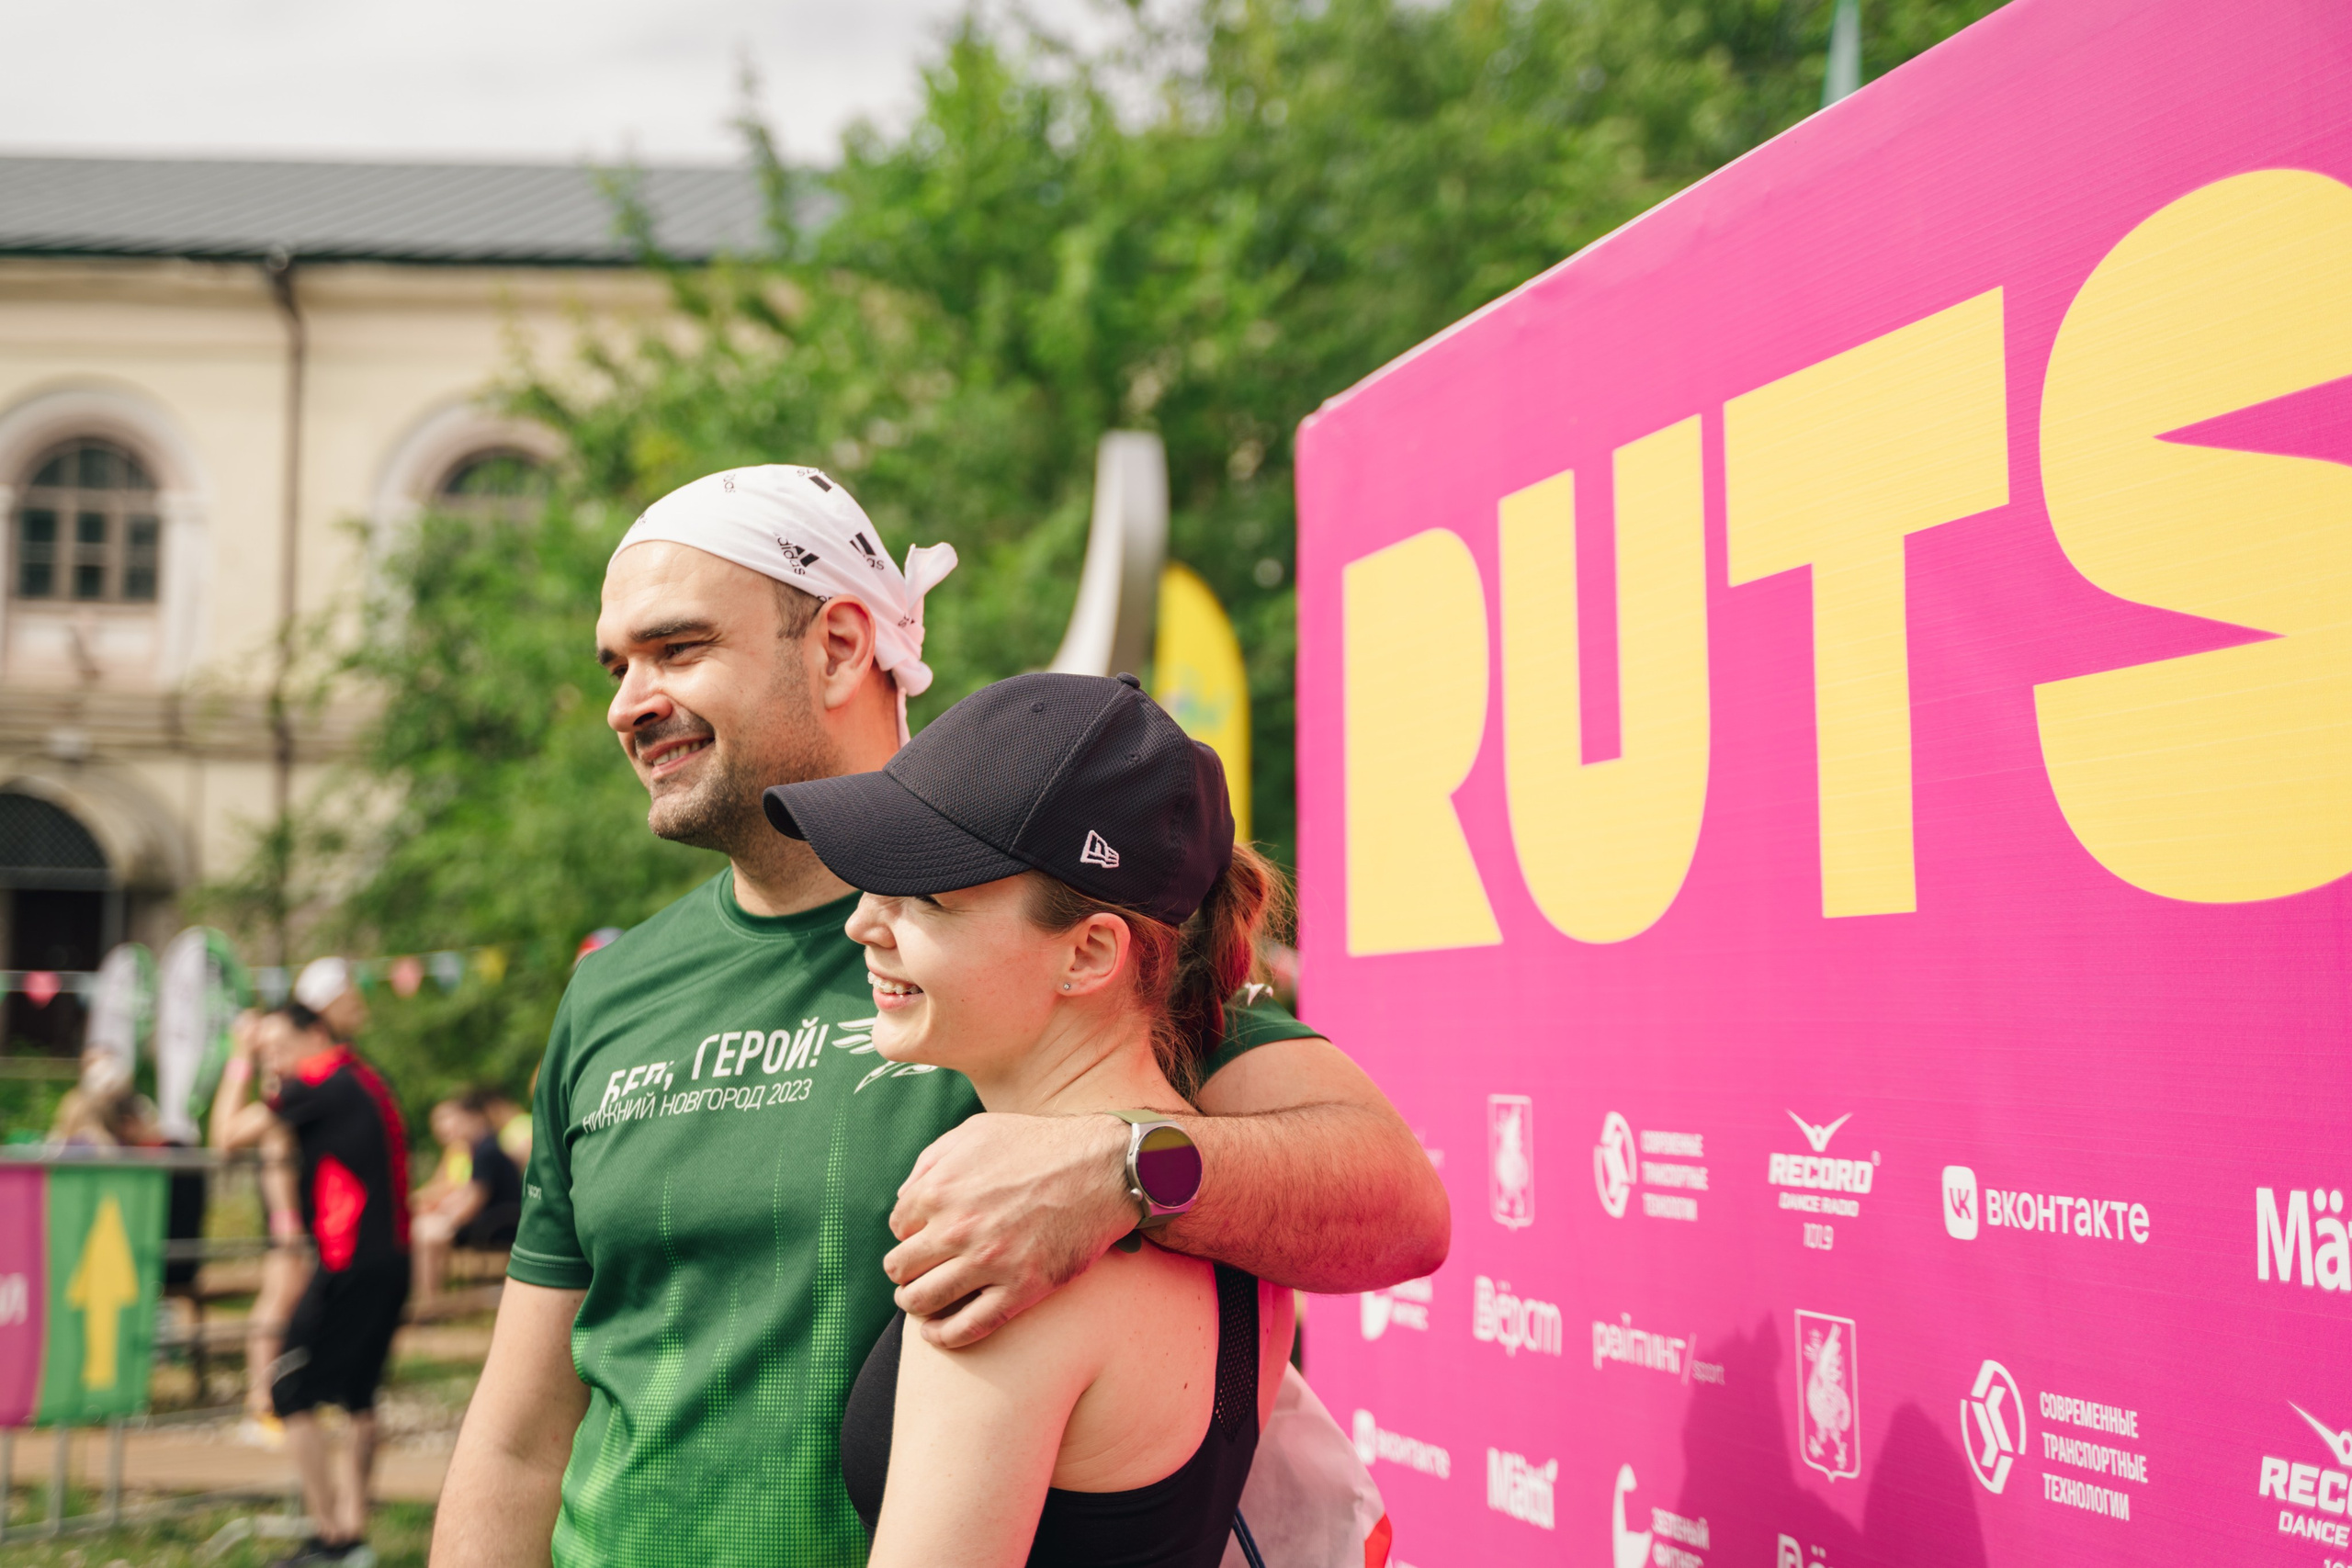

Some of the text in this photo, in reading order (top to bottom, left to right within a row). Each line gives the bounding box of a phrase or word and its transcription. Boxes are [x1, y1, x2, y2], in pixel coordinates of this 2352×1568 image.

[775, 532, 806, 575] didas
[1342, 168, 2352, 957] RUTS
[692, 1017, 829, 1080] ГЕРОЙ!
[582, 1078, 812, 1134] НИЖНИЙ НОВГОРОД 2023
[1768, 1152, 1873, 1194] RECORD
[2256, 1186, 2352, 1292] Mä
[2039, 1391, 2139, 1438] СОВРЕМЕННЫЕ
[2041, 1431, 2148, 1483] ТРАНСПОРТНЫЕ
[2041, 1472, 2130, 1521] ТЕХНОЛОГИИ
[2258, 1455, 2352, 1517] REC
[2278, 1510, 2351, 1548] DANCE
